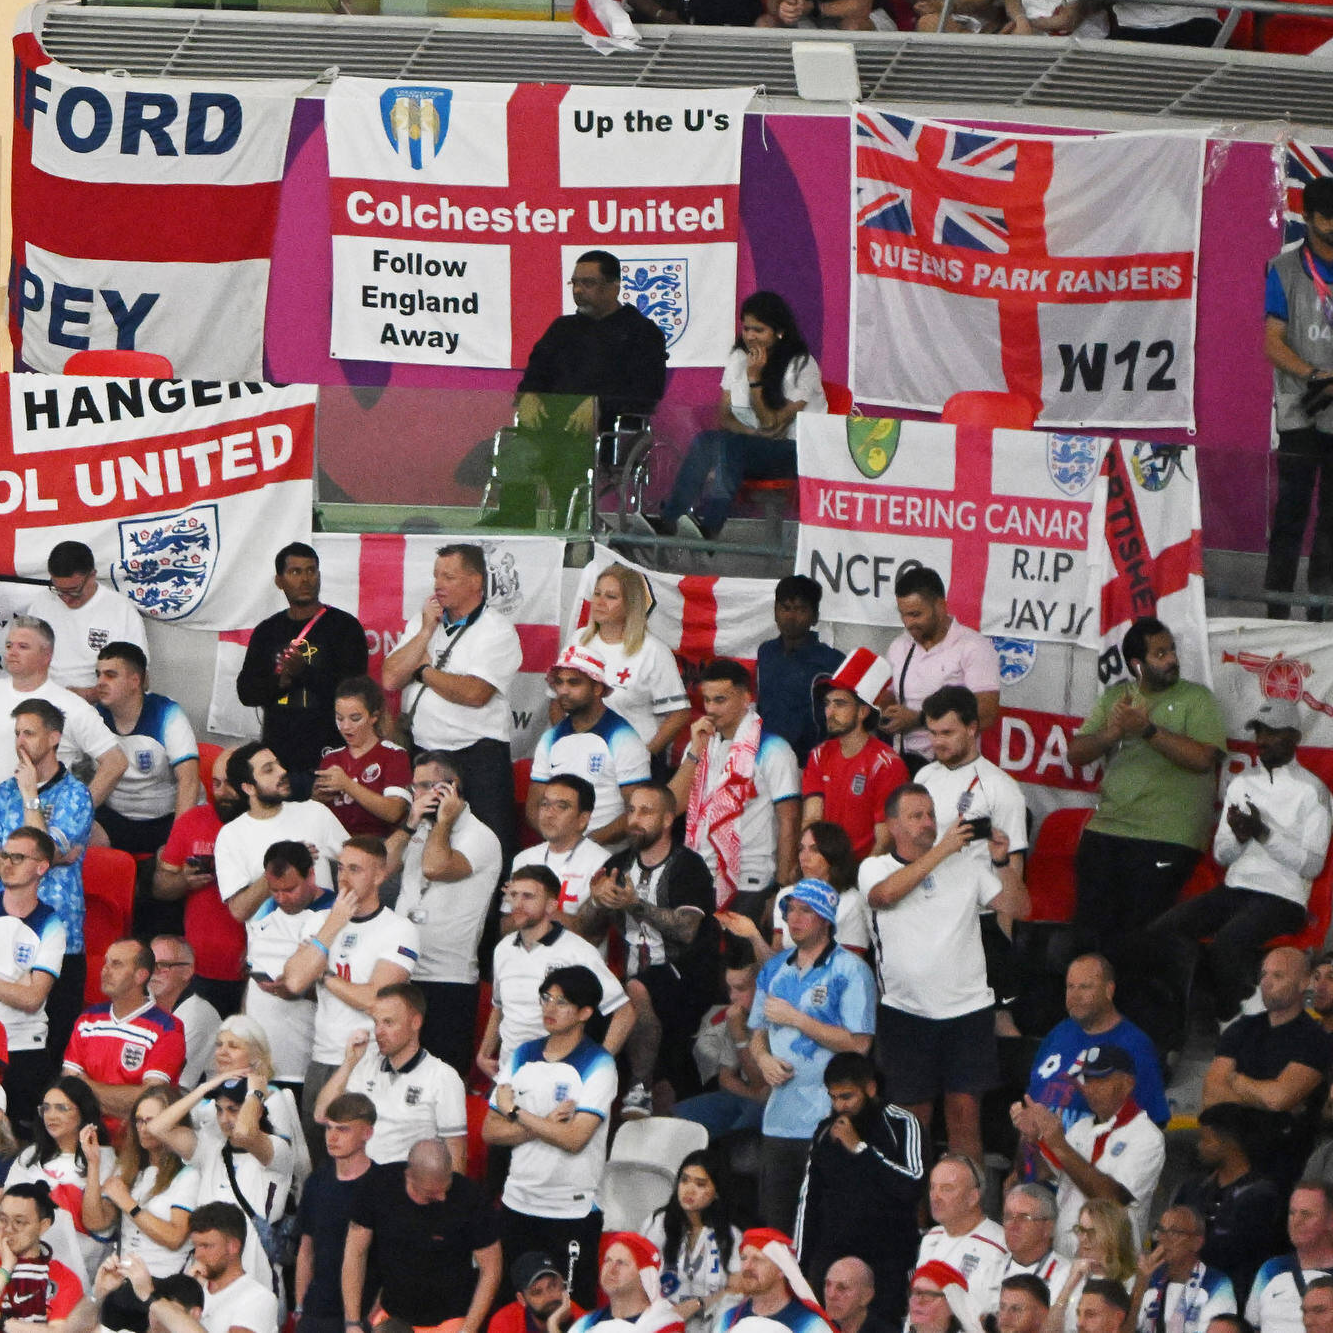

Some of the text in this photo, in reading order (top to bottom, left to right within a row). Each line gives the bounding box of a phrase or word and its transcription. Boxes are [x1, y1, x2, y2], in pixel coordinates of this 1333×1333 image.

[573, 108, 730, 138] Up the U's
[345, 189, 724, 233] Colchester United
[372, 249, 468, 277] Follow
[870, 241, 963, 282] QUEENS
[972, 263, 1050, 291] PARK
[361, 284, 479, 316] England
[380, 322, 460, 355] Away
[1058, 339, 1176, 392] W12
[75, 423, 293, 508] UNITED
[817, 488, 1085, 540] KETTERING CANAR
[1005, 597, 1058, 632] JAY
